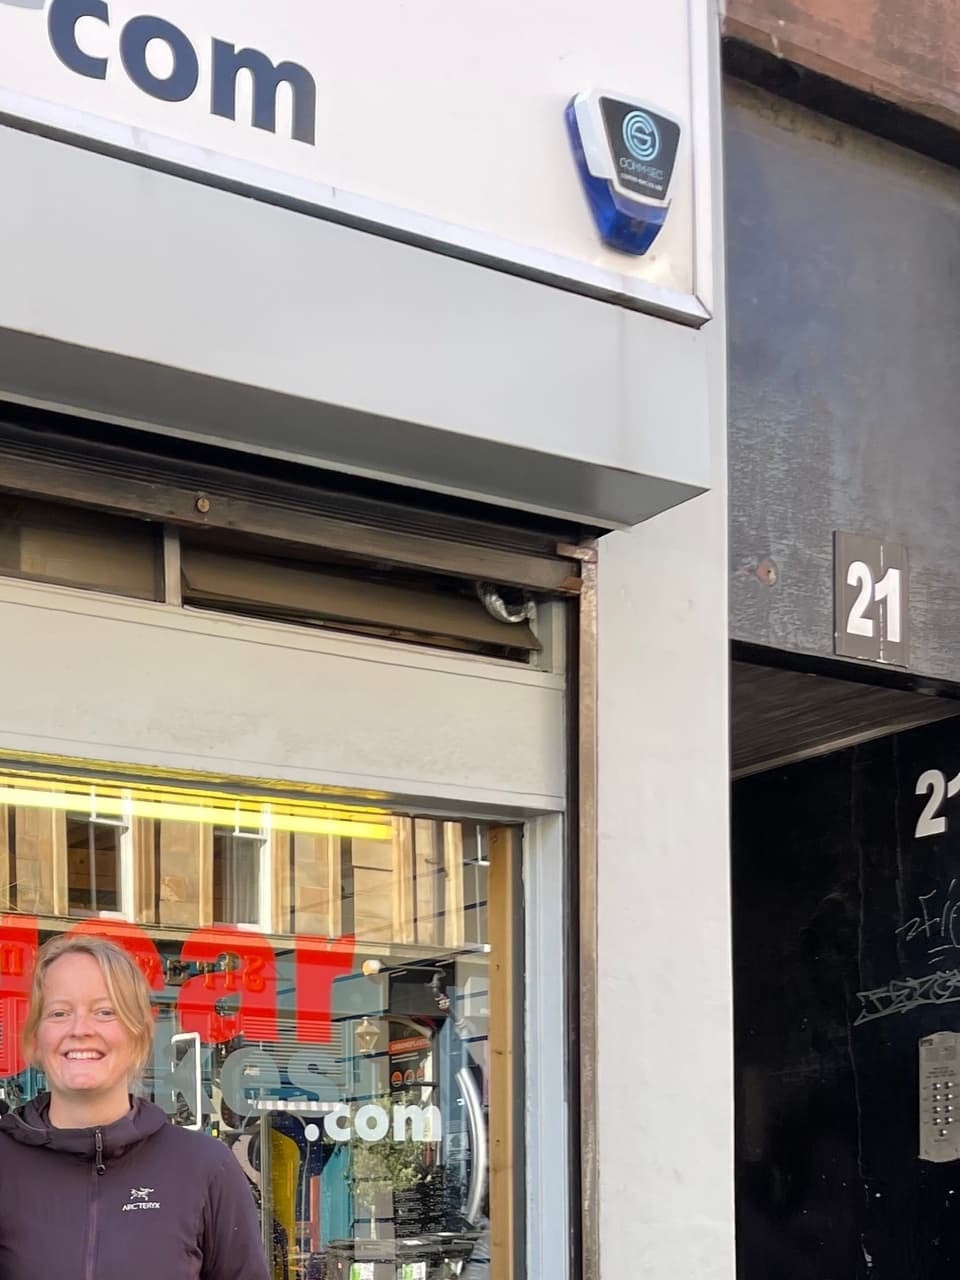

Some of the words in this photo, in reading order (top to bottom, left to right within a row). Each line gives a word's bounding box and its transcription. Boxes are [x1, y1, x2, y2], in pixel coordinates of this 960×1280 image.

[47, 0, 317, 146] com
[846, 560, 901, 643] 21
[914, 768, 960, 839] 2
[304, 1102, 442, 1143] .com
